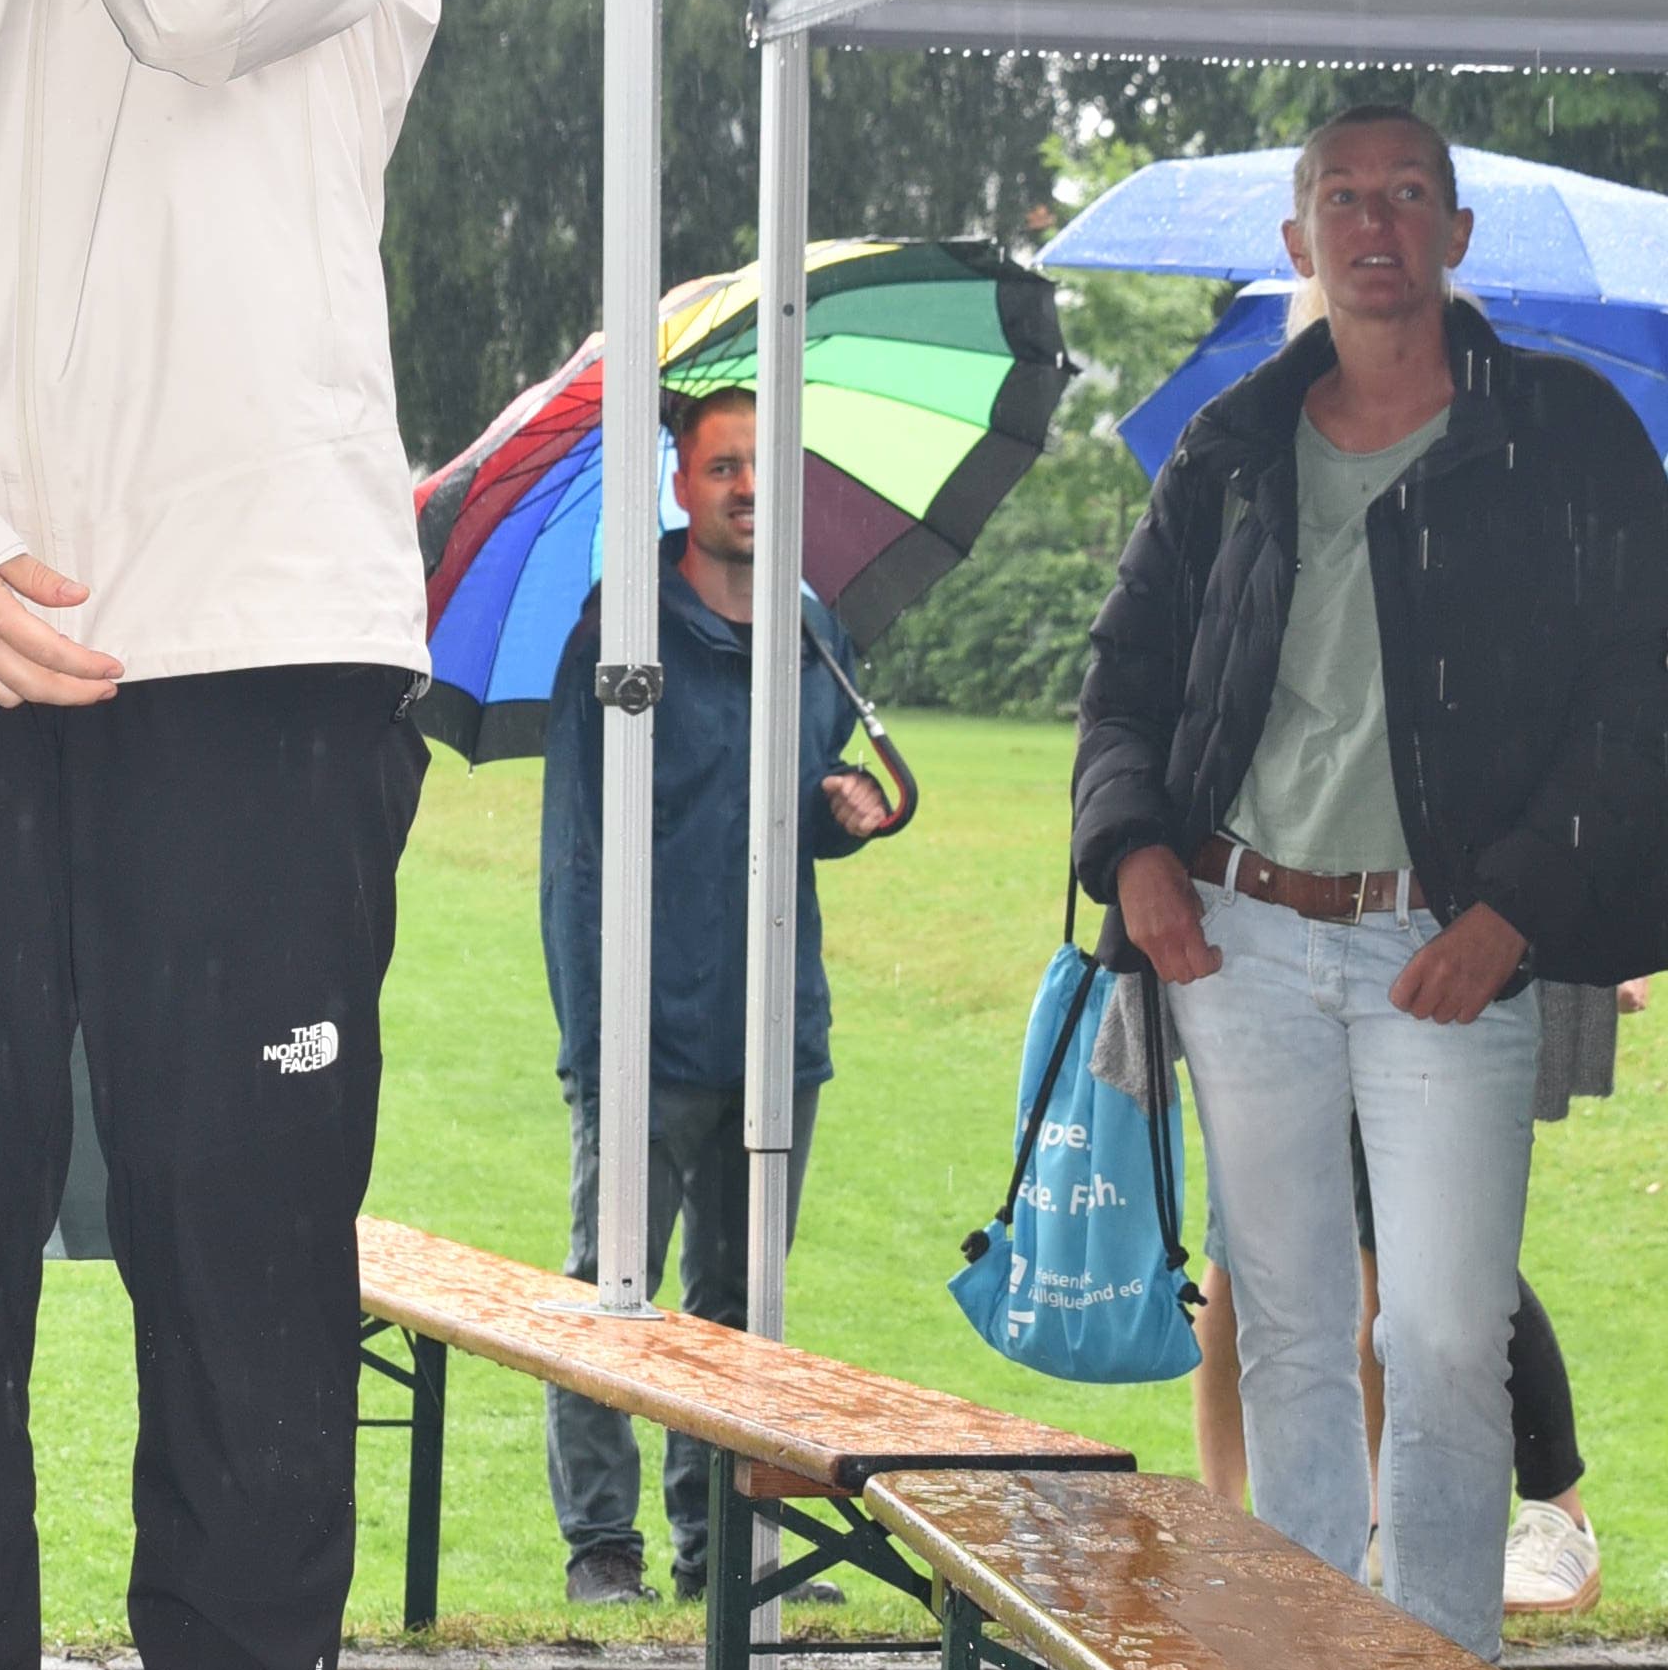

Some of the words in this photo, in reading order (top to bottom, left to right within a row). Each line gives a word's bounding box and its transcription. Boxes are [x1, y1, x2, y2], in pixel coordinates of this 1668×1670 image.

[291, 1023, 322, 1043] THE
[263, 1038, 321, 1061] NORTH
[280, 1054, 322, 1074] FACE
[1119, 1278, 1144, 1298] eG
